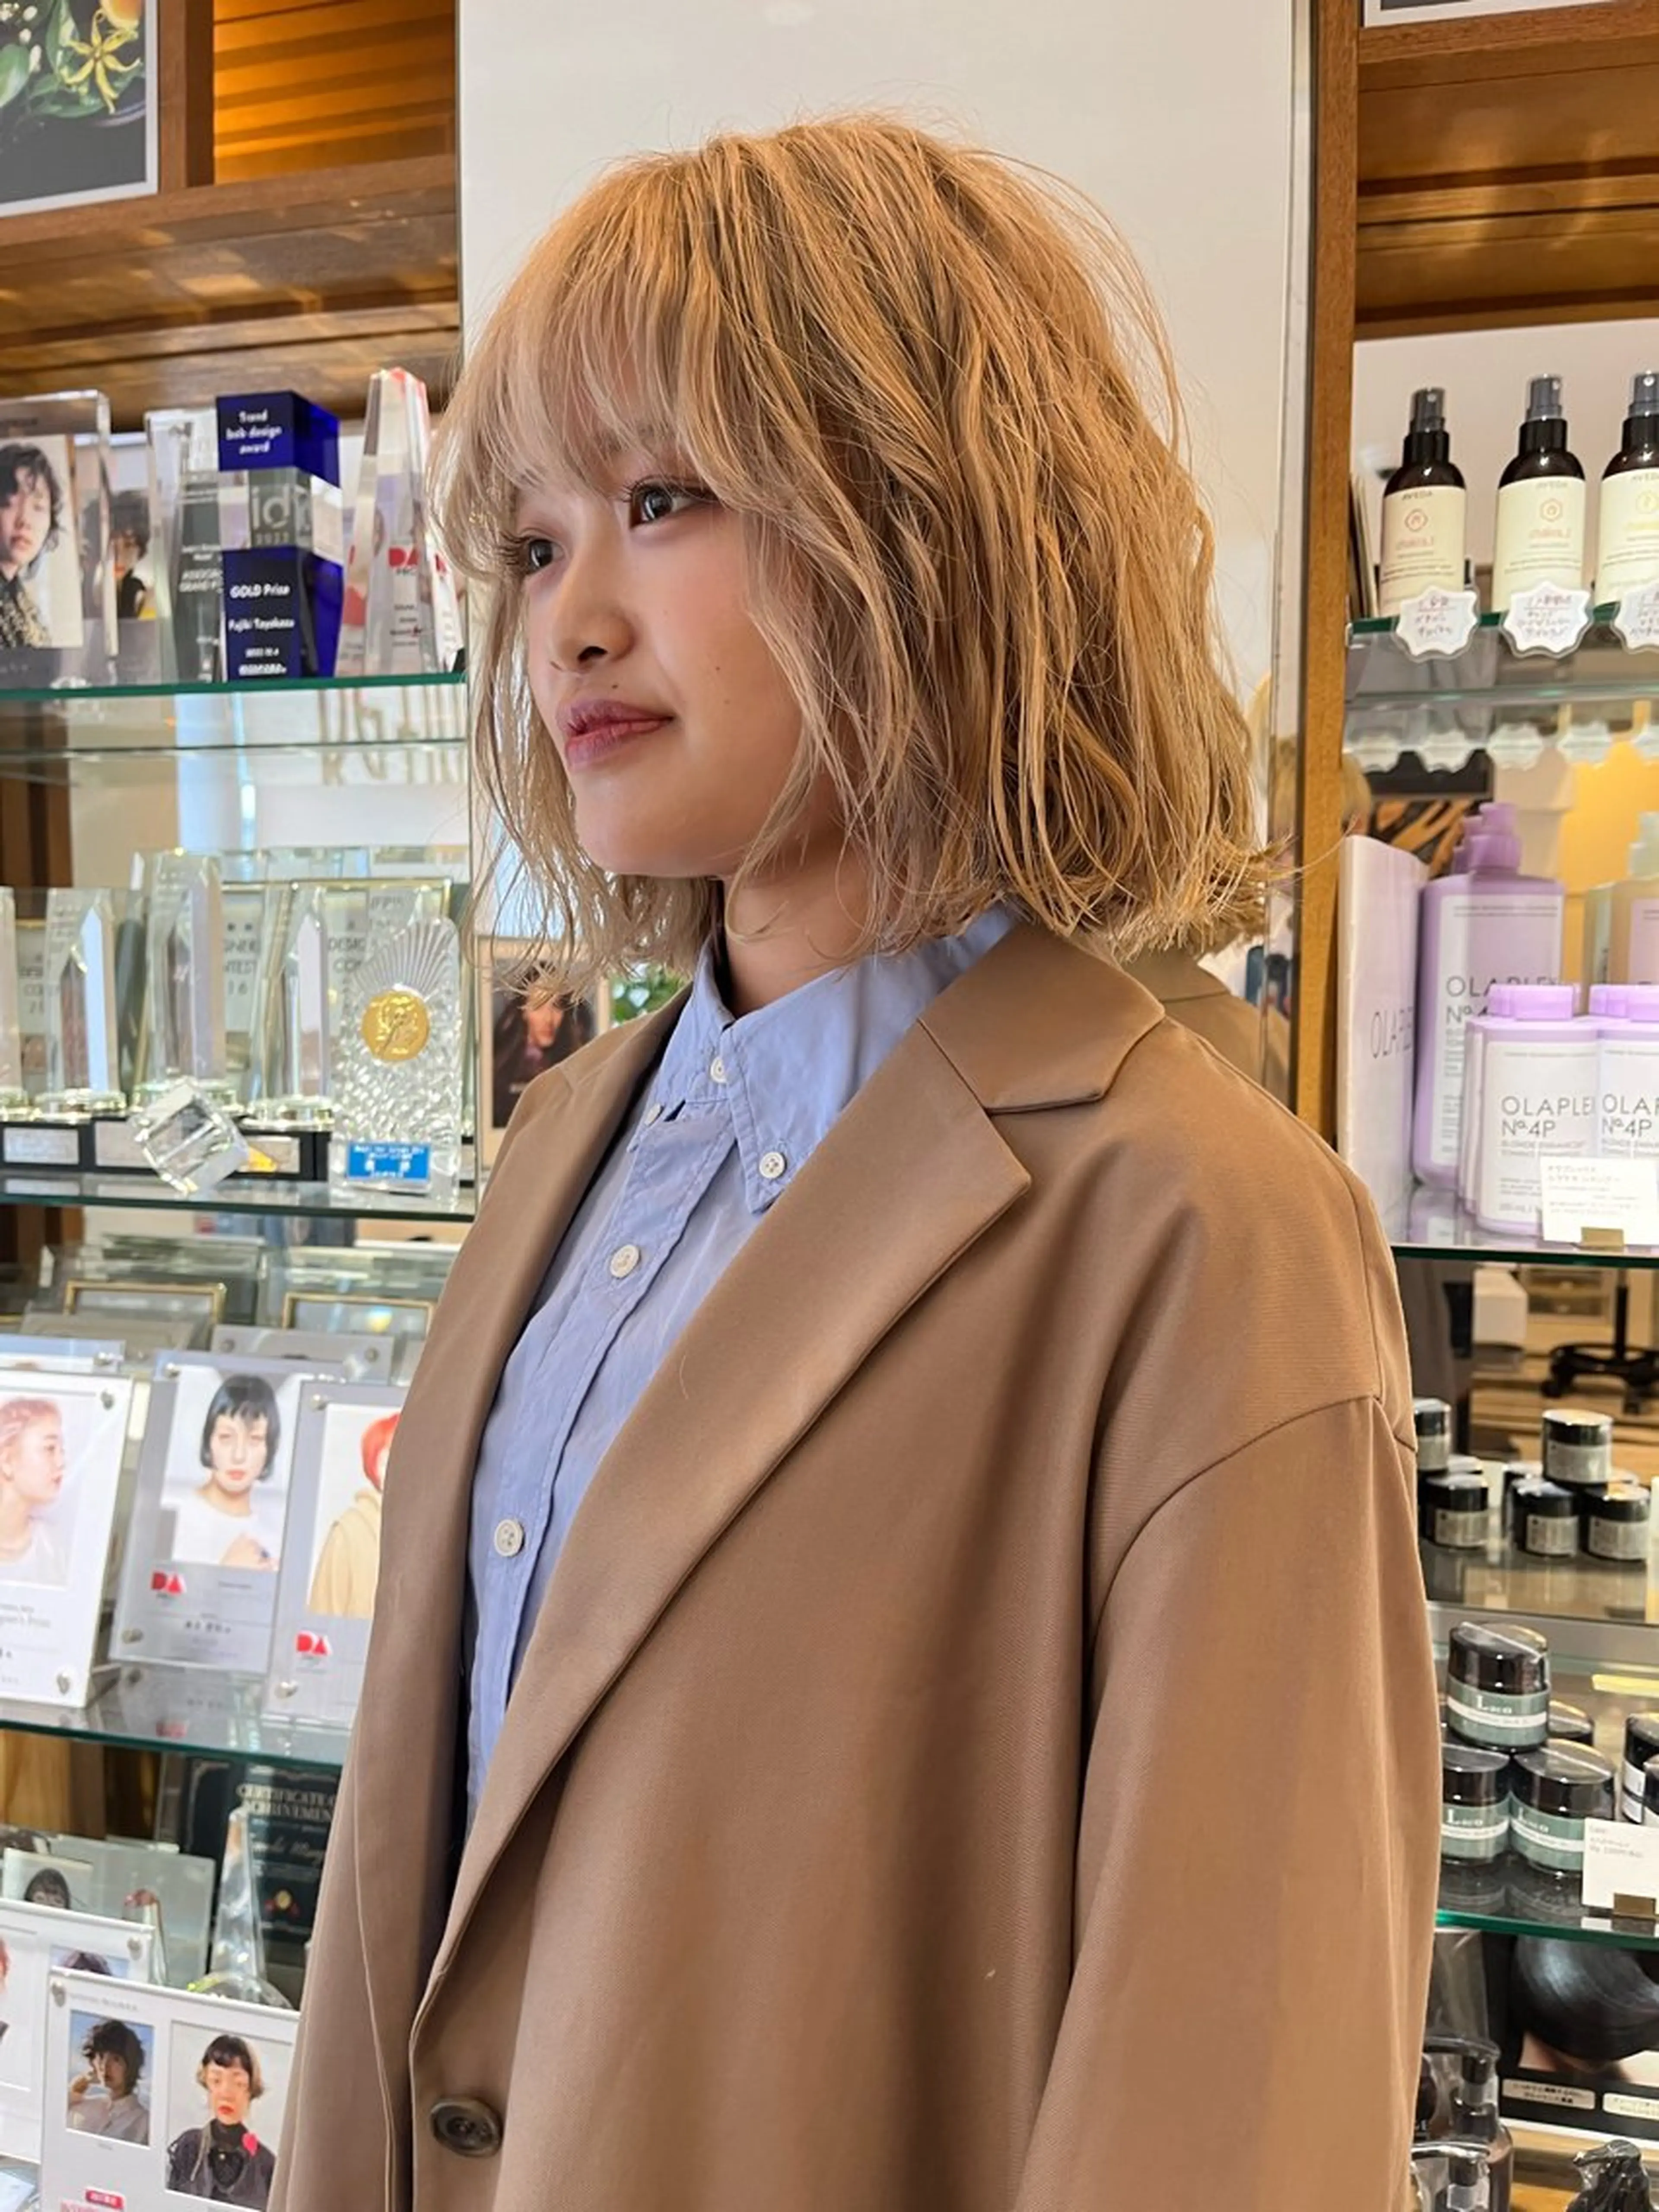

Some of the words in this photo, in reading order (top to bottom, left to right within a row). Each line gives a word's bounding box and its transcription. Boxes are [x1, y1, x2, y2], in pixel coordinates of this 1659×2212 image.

[248, 425, 283, 440] design
[239, 440, 270, 454] award
[229, 584, 262, 599] GOLD
[1501, 1096, 1595, 1116] OLAPLE
